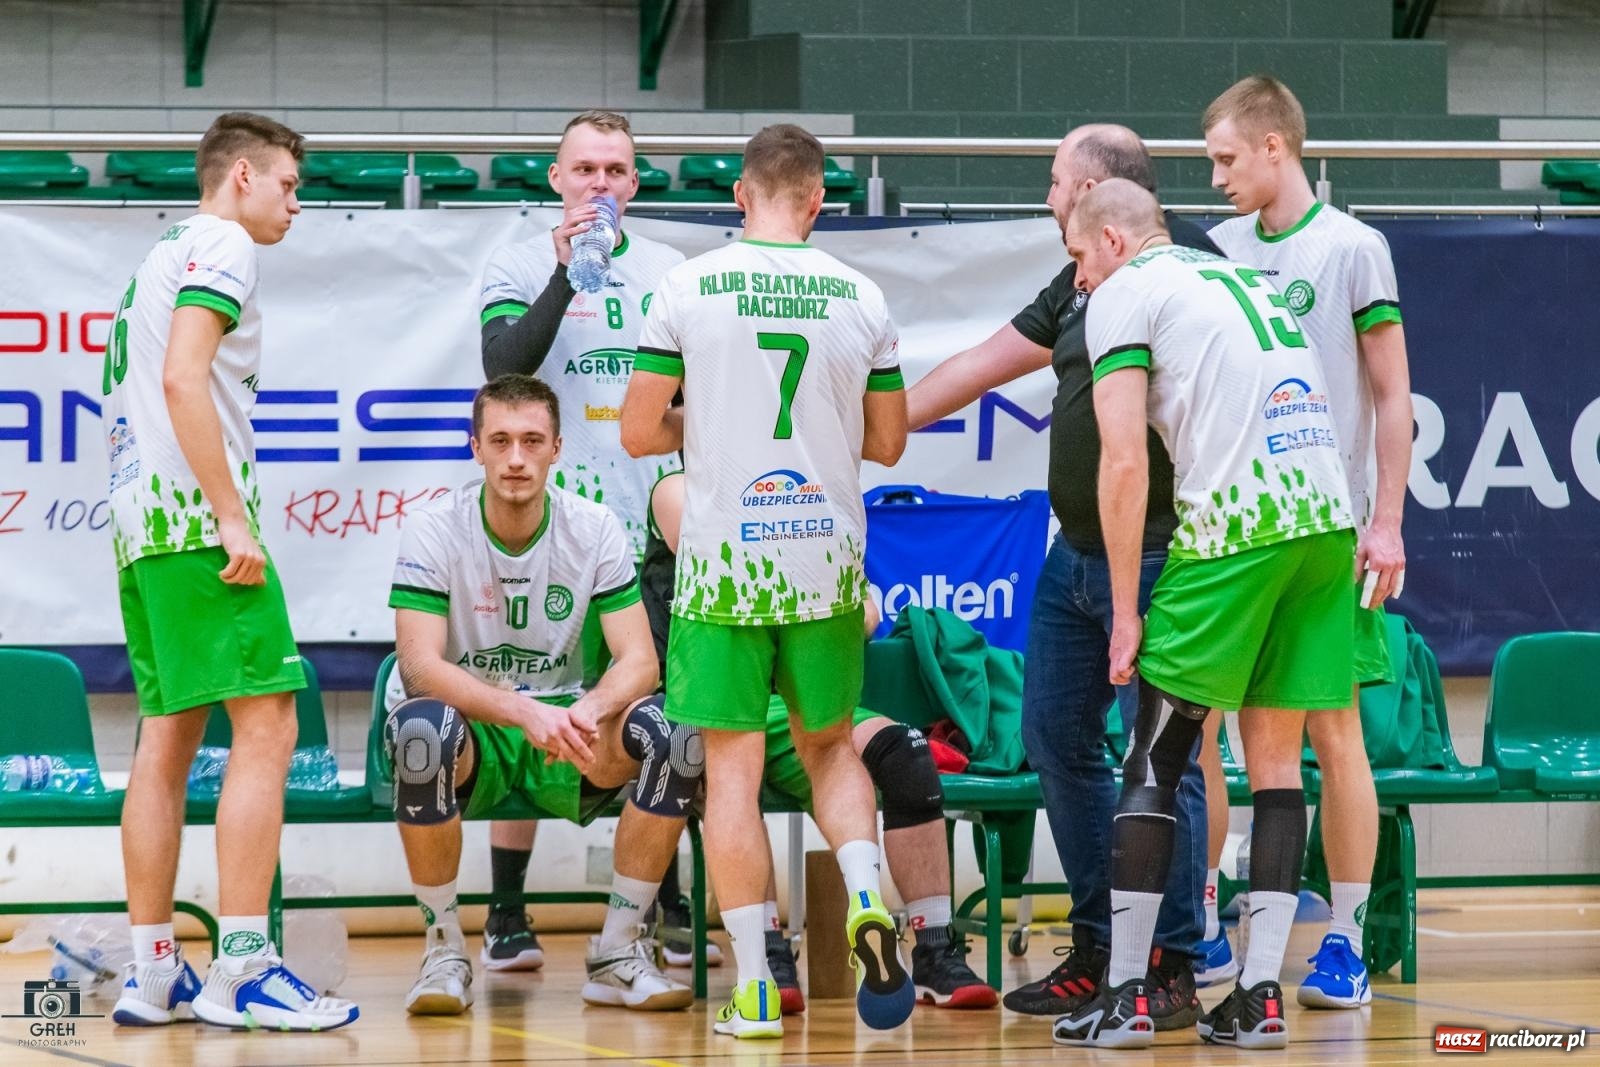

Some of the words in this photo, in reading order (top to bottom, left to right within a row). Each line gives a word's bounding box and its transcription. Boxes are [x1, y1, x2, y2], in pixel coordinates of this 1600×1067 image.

[700, 272, 746, 295] KLUB
[751, 272, 859, 301] SIATKARSKI
[605, 297, 624, 330] 8
[737, 295, 829, 320] RACIBÓRZ
[1198, 267, 1308, 351] 13
[757, 332, 810, 440] 7
[504, 595, 529, 630] 10
